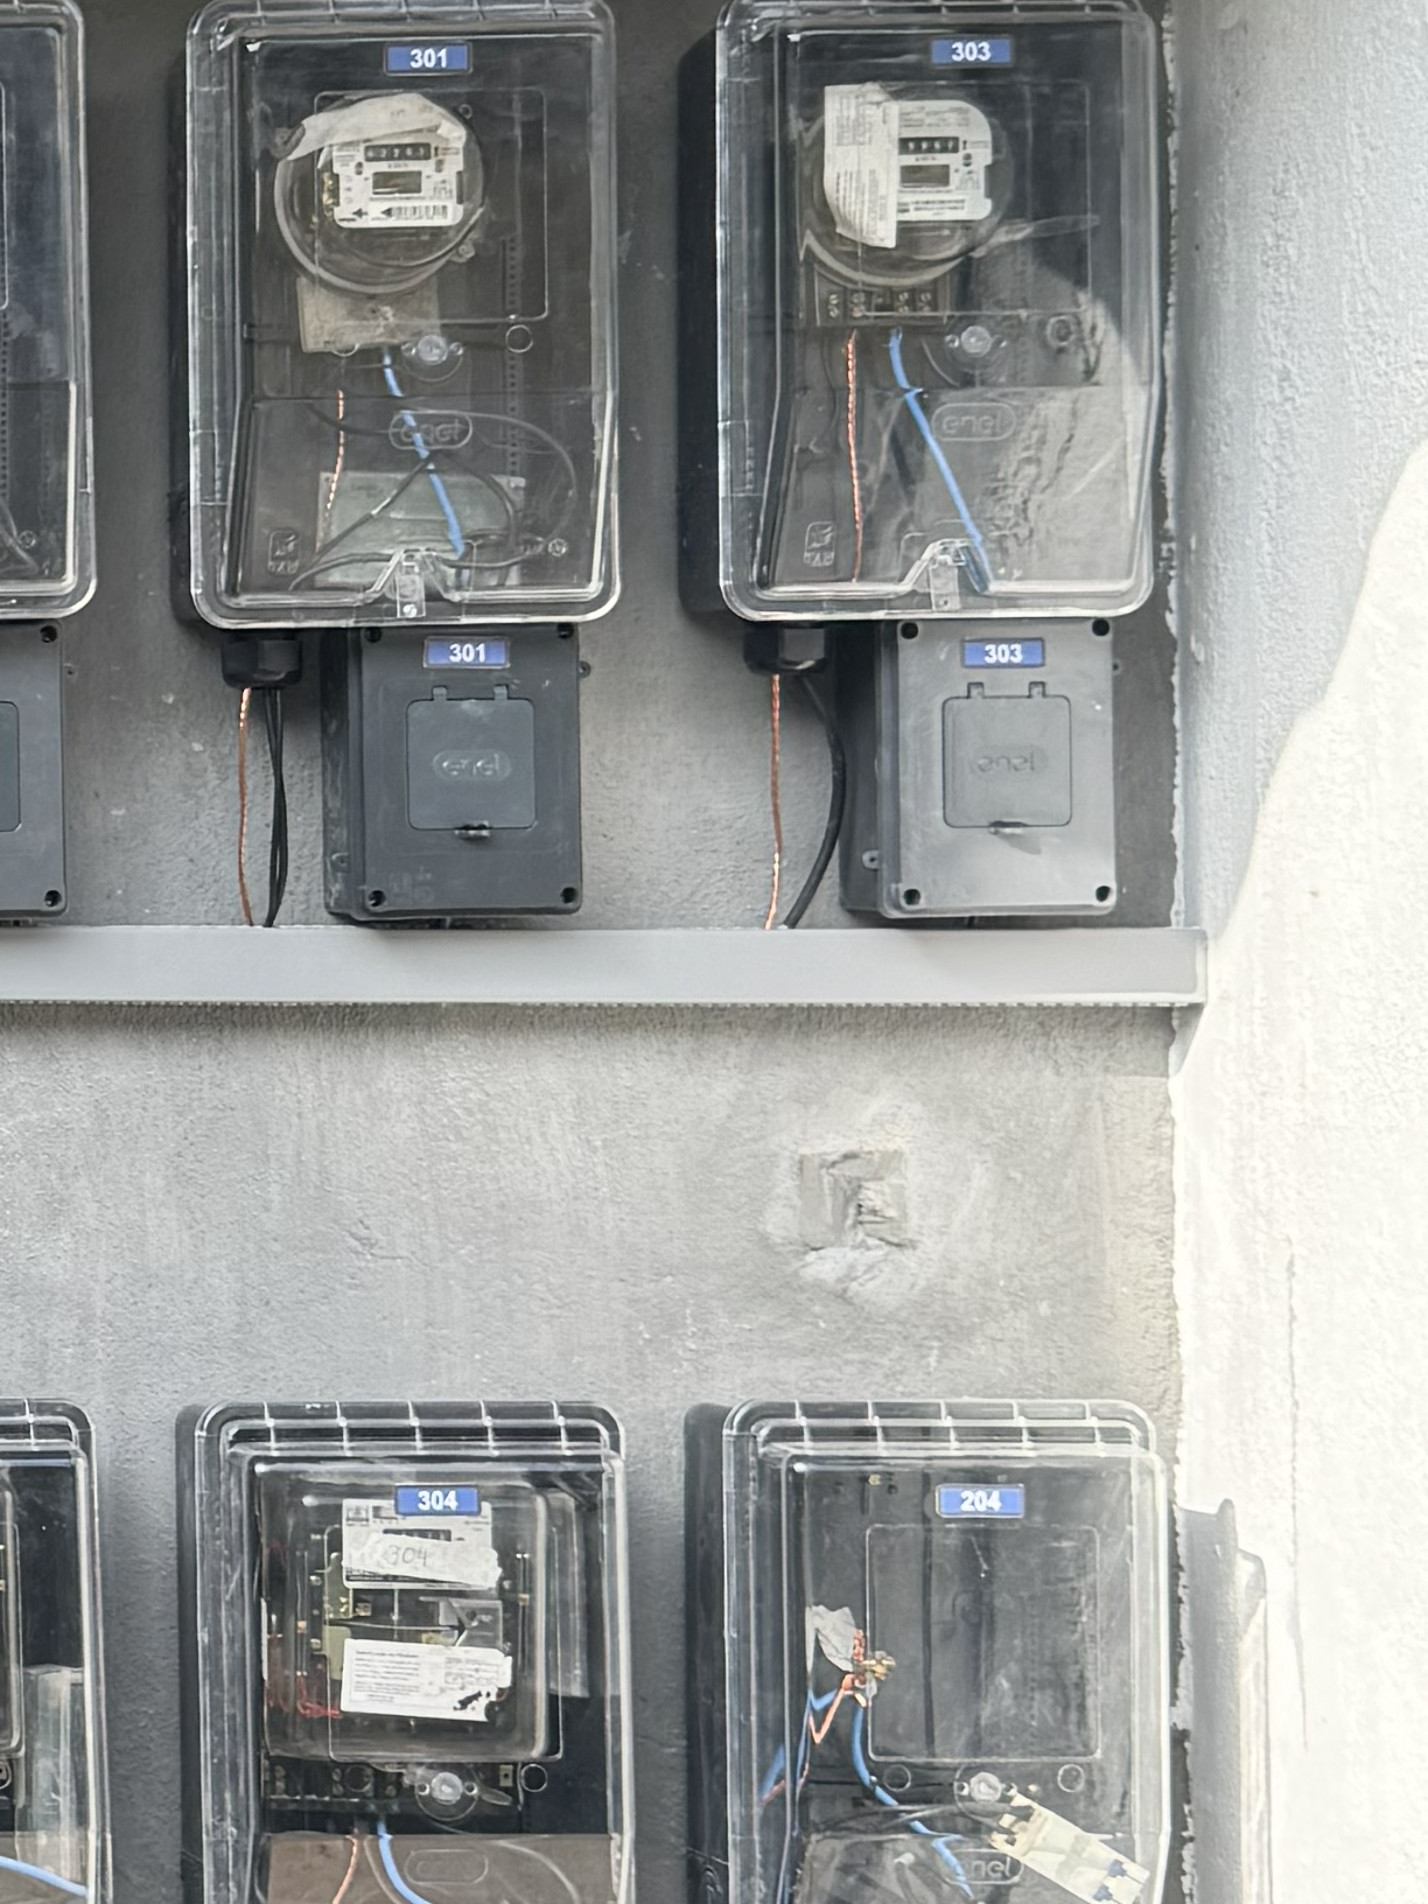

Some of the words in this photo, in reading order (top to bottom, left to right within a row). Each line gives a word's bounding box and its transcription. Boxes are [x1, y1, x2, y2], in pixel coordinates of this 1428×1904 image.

[409, 47, 447, 69] 301
[951, 41, 992, 62] 303
[941, 413, 1004, 436] enel
[448, 643, 486, 663] 301
[983, 643, 1024, 664] 303
[442, 753, 500, 777] enel
[976, 751, 1036, 773] enel
[417, 1489, 459, 1511] 304
[960, 1489, 1002, 1511] 204
[385, 1544, 428, 1568] 304
